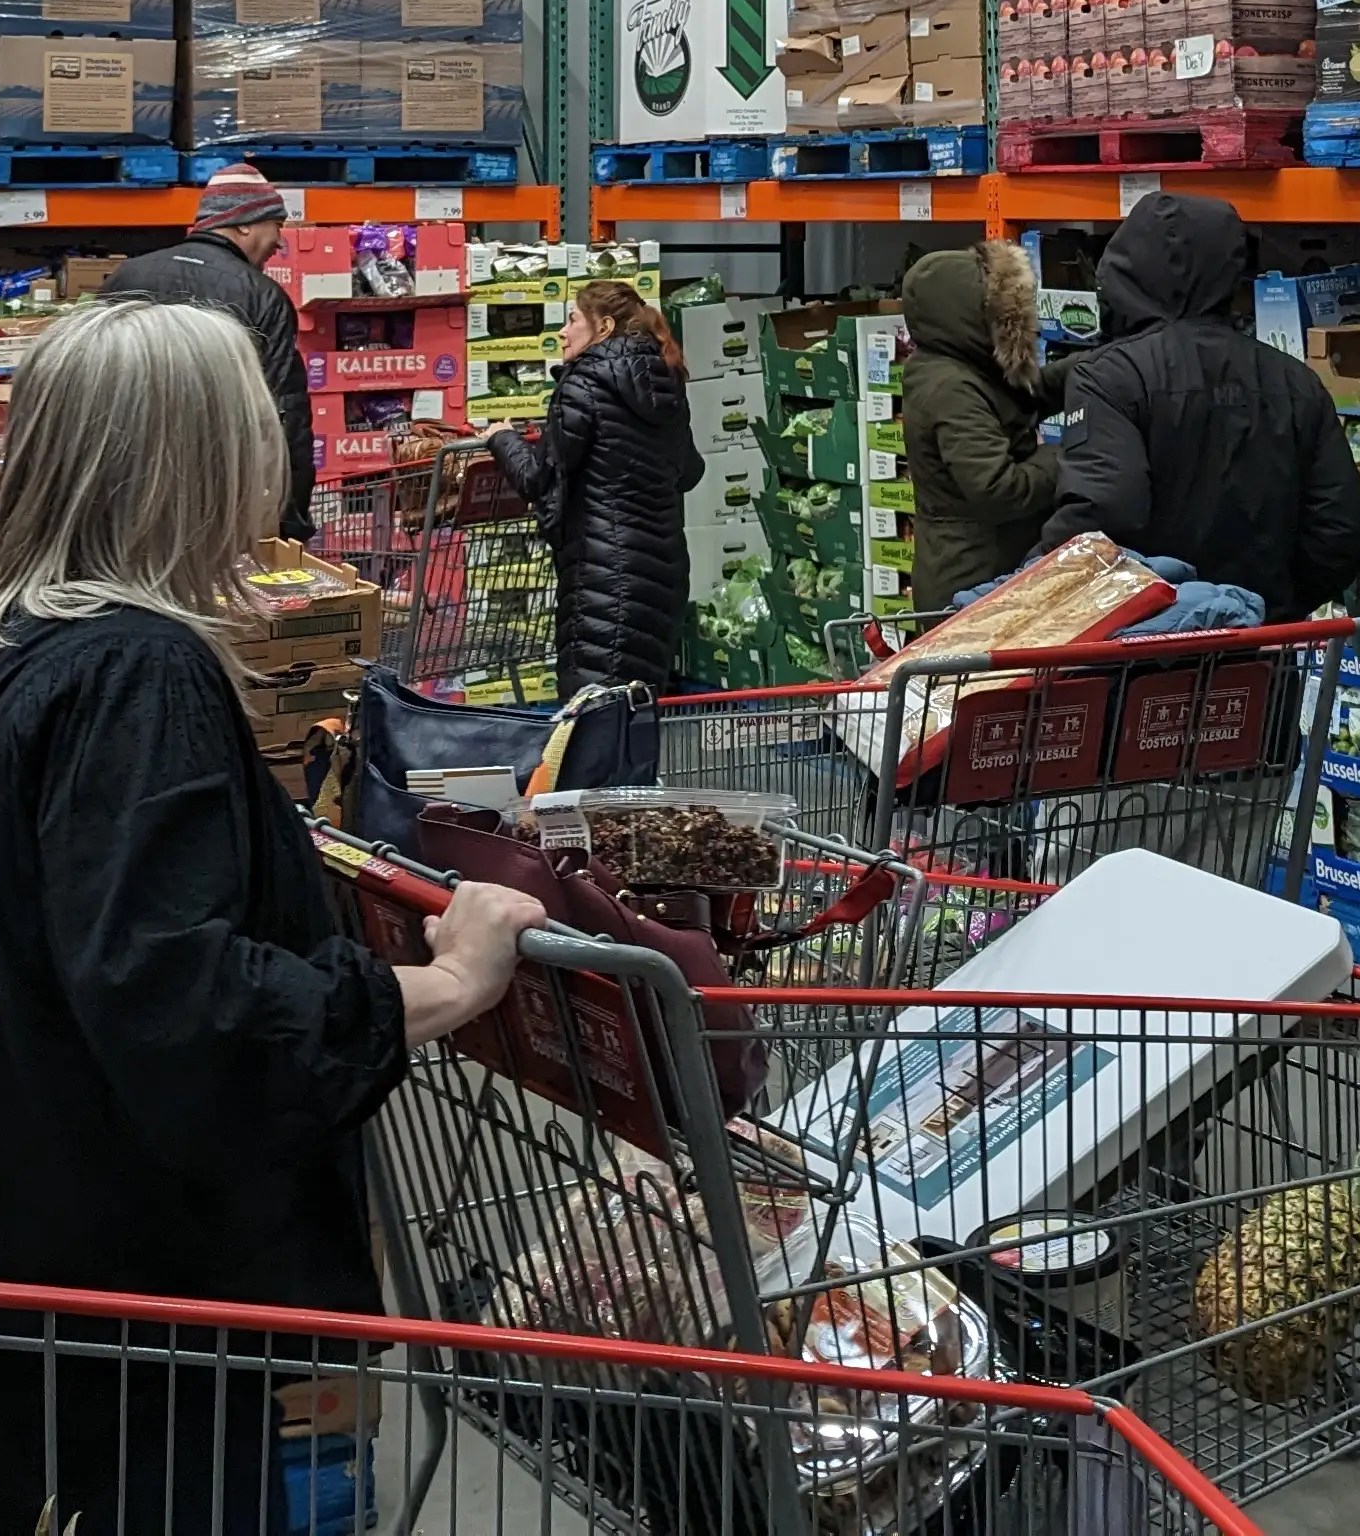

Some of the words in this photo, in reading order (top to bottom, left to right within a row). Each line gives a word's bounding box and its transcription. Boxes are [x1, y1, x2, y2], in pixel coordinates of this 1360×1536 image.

[1240, 9, 1293, 22] HONEYCRISP
[1241, 78, 1295, 90] HONEYCRISP
[24, 211, 45, 222] 5.99
[443, 208, 461, 218] 7.99
[917, 206, 930, 218] 5.99
[336, 355, 427, 374] KALETTES
[1066, 407, 1084, 426] HH
[1122, 633, 1165, 644] COSTCO
[1168, 628, 1230, 640] WHOLESALE
[1140, 736, 1179, 751] COSTCO
[972, 753, 1013, 770] COSTCO
